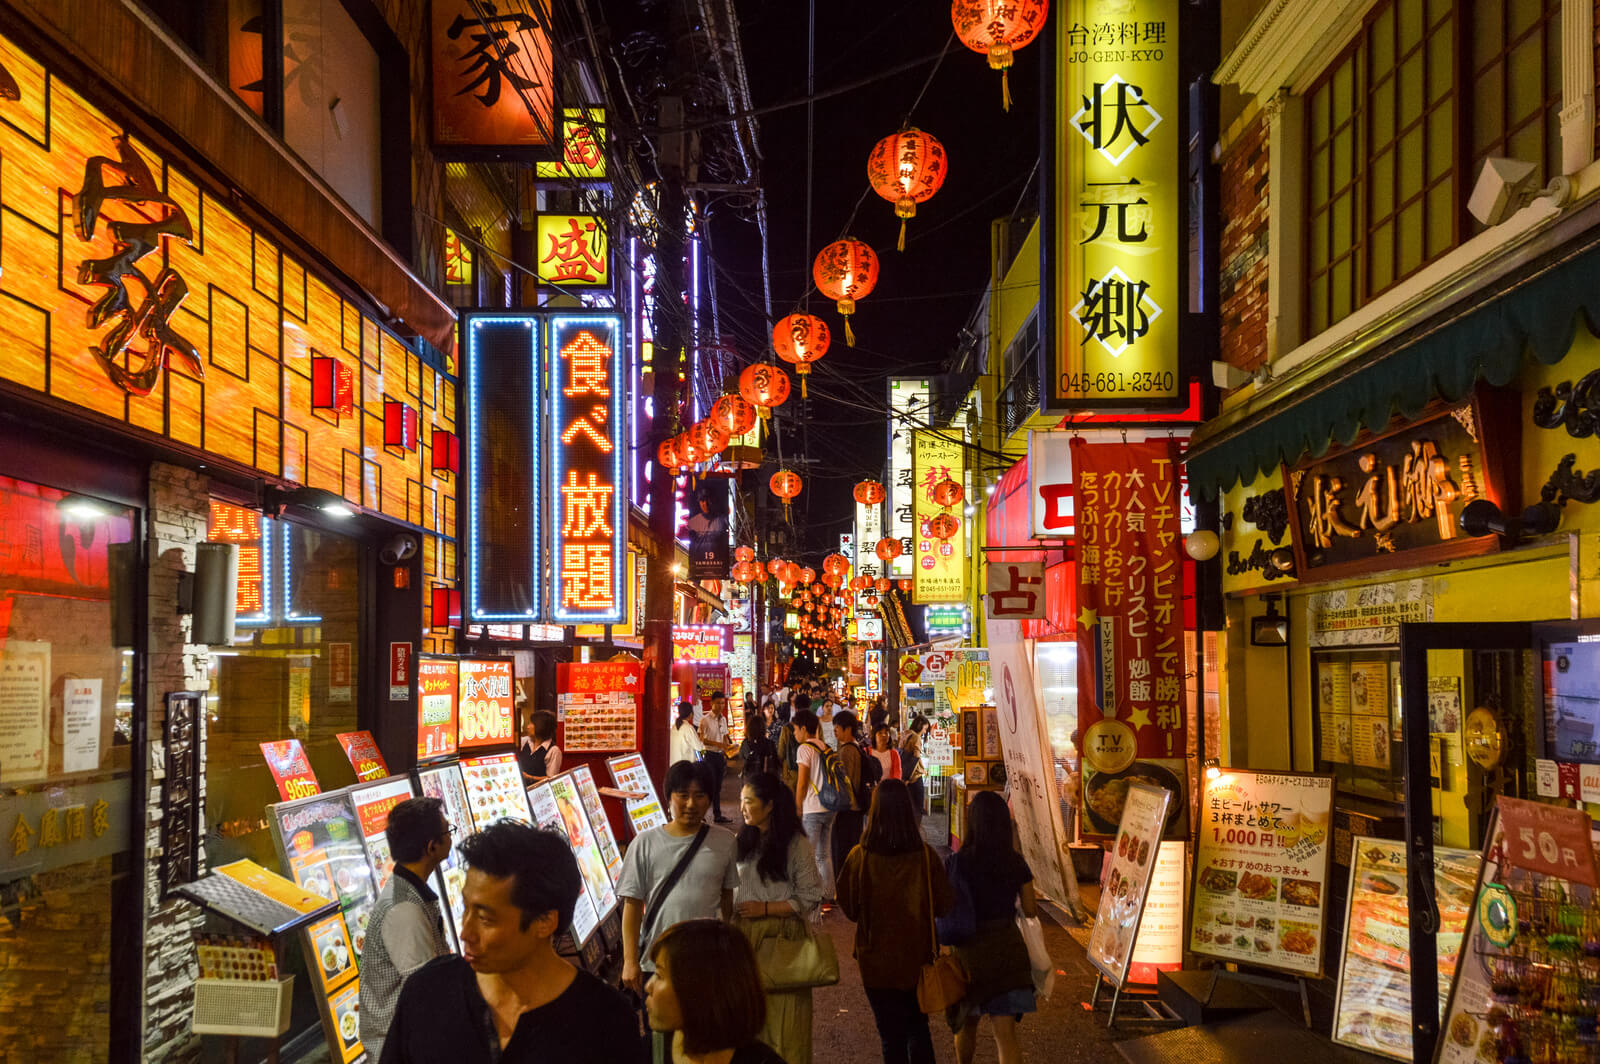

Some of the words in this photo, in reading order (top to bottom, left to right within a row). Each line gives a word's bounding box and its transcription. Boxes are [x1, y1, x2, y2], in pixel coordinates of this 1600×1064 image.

[446, 1, 543, 107] 家
[1068, 21, 1167, 46] 台湾料理
[1069, 49, 1164, 64] JO-GEN-KYO
[1079, 82, 1151, 346] 状元郷
[1060, 371, 1174, 394] 045-681-2340
[560, 330, 614, 609] 食べ放題
[1079, 470, 1101, 585] たっぷり海鮮
[1102, 470, 1125, 607] カリカリおこげ
[991, 566, 1043, 617] 占
[466, 676, 510, 698] 食べ放題
[1098, 734, 1122, 746] TV
